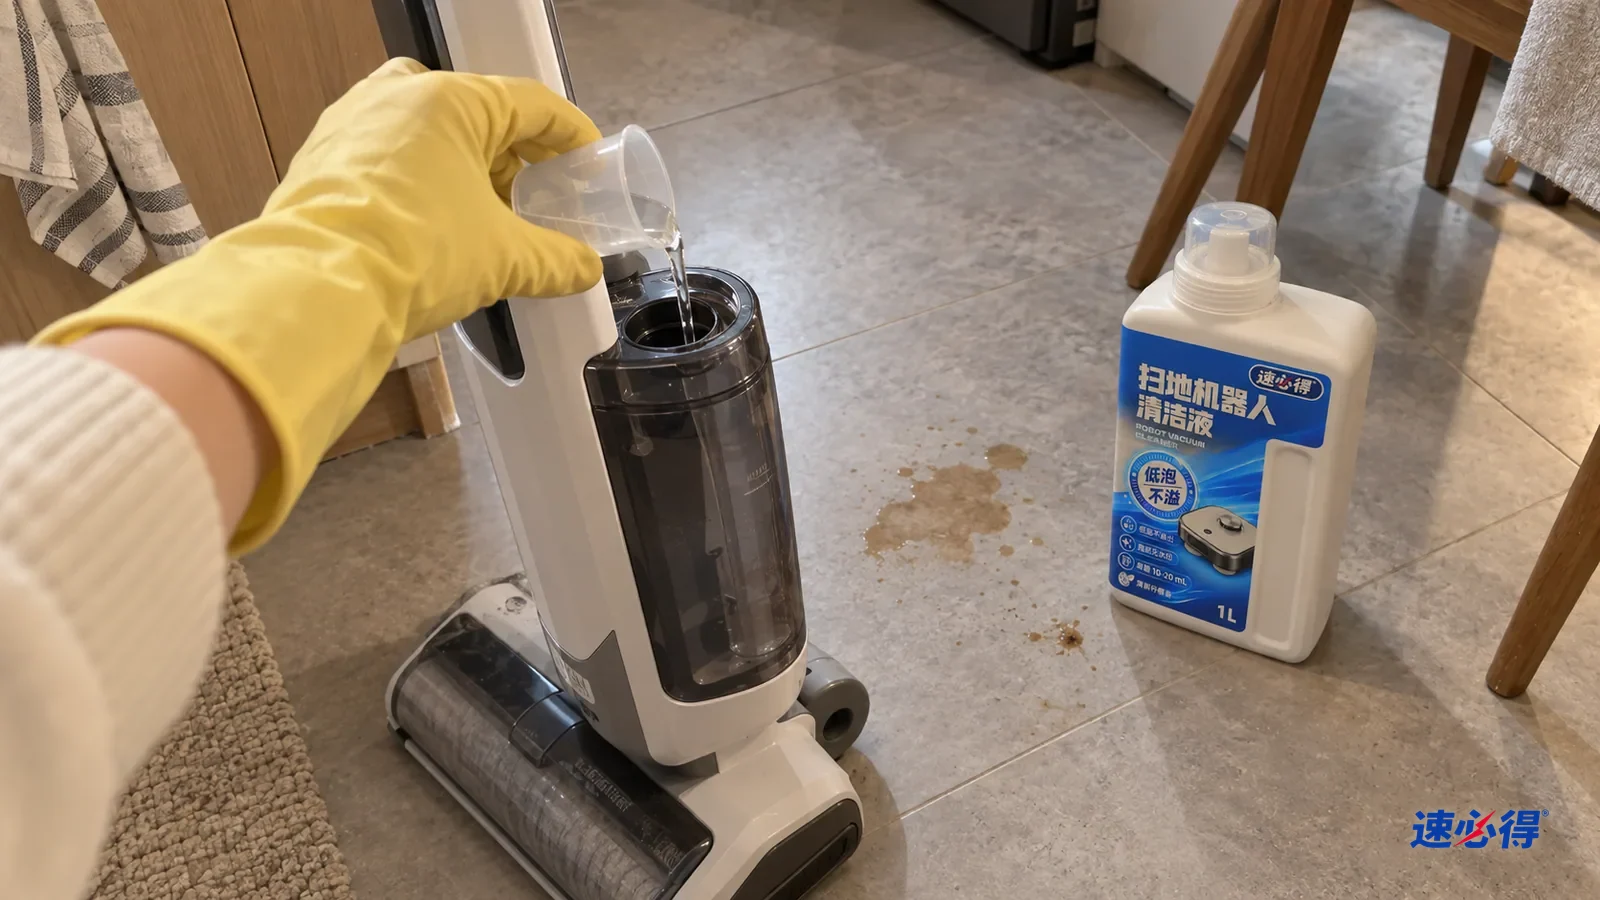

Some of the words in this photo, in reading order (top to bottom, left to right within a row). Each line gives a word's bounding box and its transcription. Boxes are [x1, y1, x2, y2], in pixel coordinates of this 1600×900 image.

[1139, 363, 1276, 426] 扫地机器人
[1256, 369, 1312, 395] 速必得
[1136, 394, 1213, 438] 清洁液
[1135, 423, 1166, 437] ROBOT
[1167, 431, 1206, 448] VACUUM
[1144, 466, 1177, 484] 低泡
[1148, 488, 1181, 506] 不溢
[1217, 604, 1237, 624] 1L
